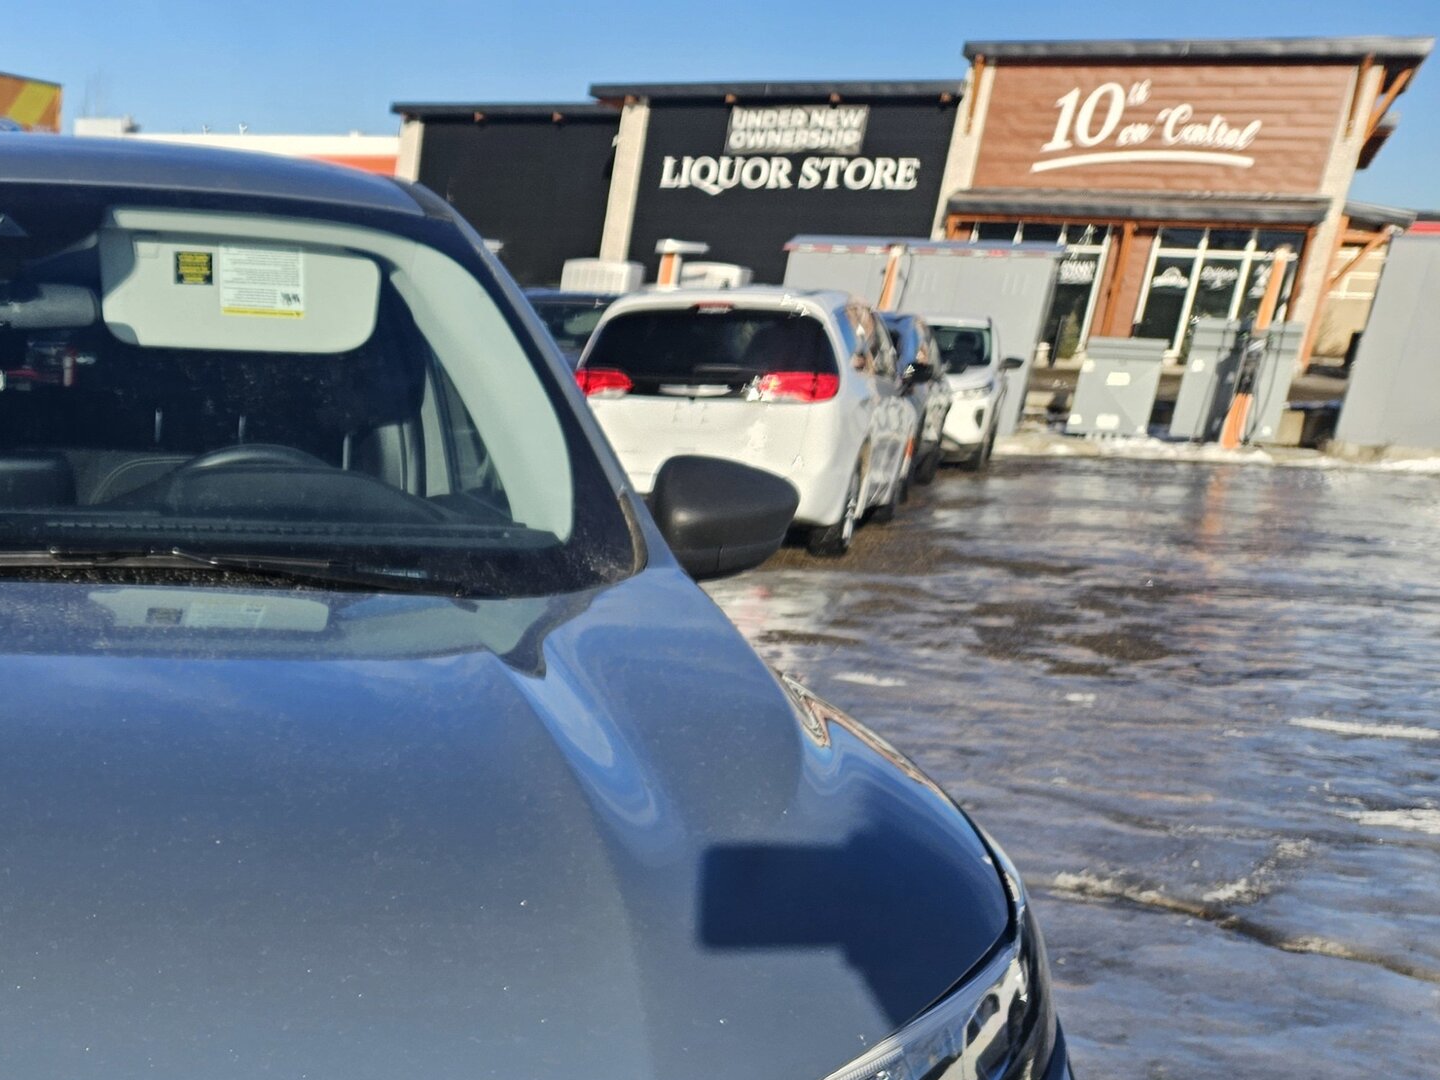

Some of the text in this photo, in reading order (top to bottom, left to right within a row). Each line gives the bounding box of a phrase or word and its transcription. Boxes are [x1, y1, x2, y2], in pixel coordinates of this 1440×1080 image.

[731, 107, 866, 129] UNDER NEW
[1155, 103, 1263, 151] Central
[728, 127, 862, 150] OWNERSHIP
[659, 155, 921, 196] LIQUOR STORE
